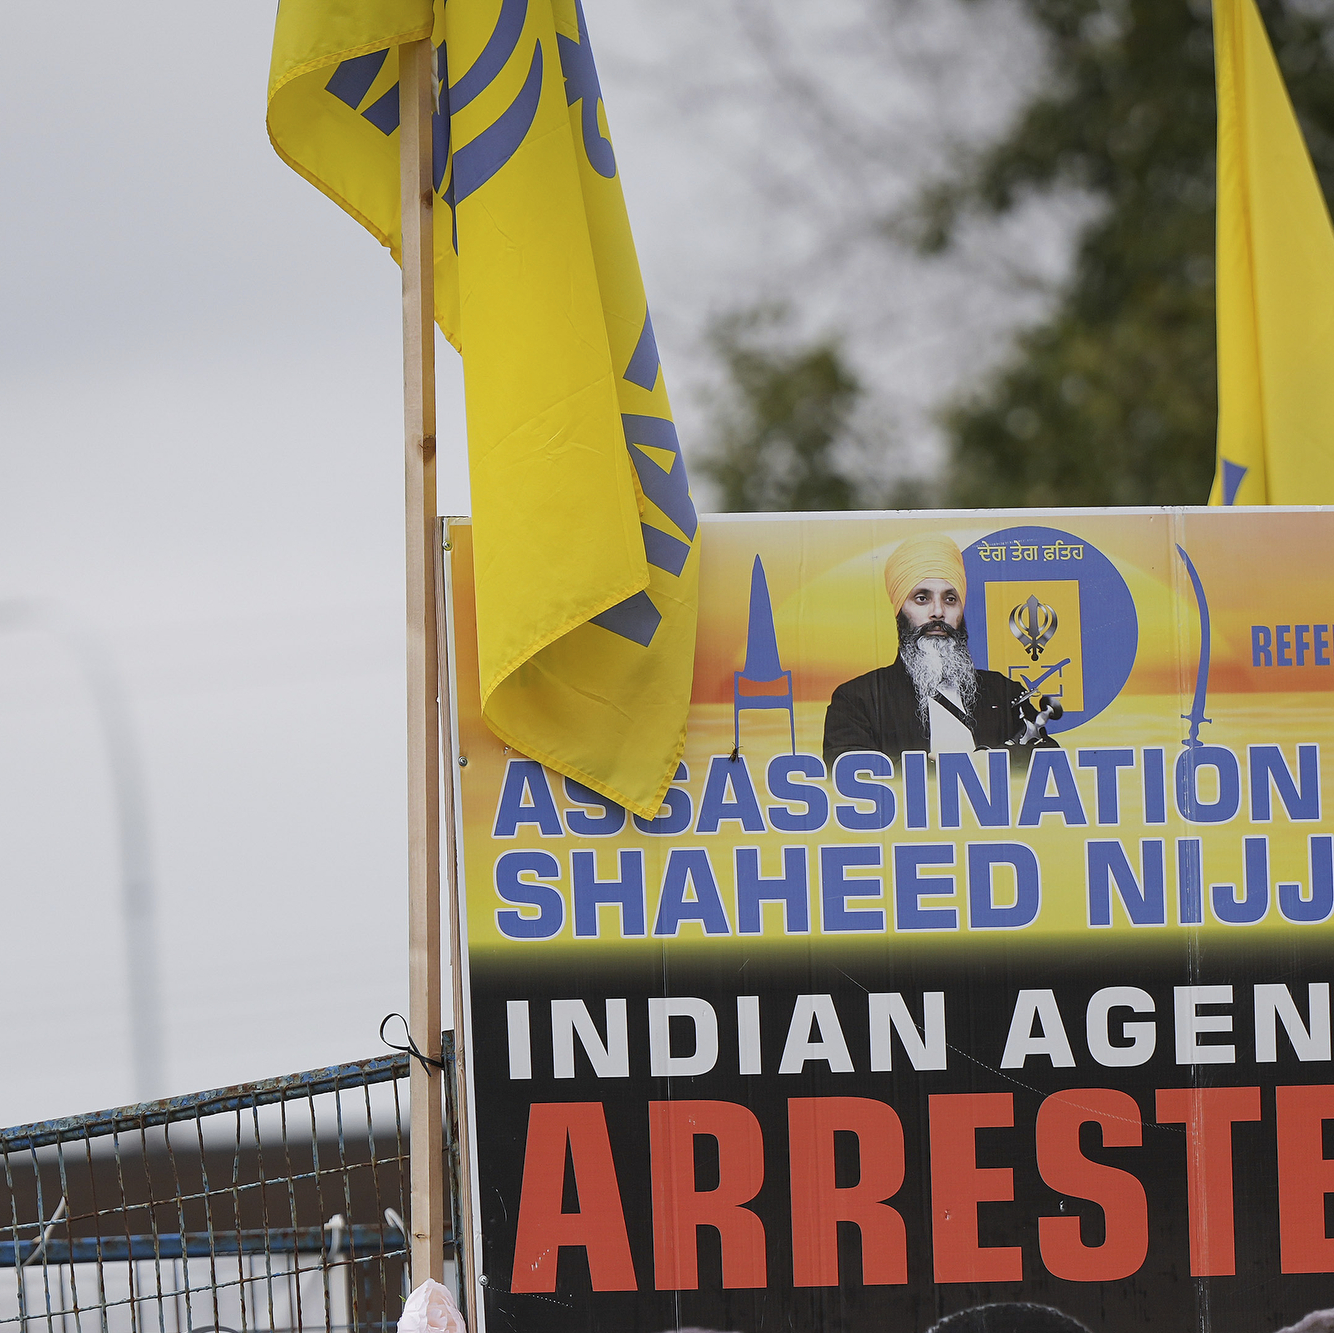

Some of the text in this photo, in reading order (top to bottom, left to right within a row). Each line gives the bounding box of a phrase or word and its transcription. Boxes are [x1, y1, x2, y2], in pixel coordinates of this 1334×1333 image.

[978, 540, 1007, 562] ਦੇਗ
[1010, 540, 1038, 562] ਤੇਗ
[492, 744, 1323, 839] ASSASSINATION
[493, 842, 1043, 941] SHAHEED
[507, 992, 946, 1079] INDIAN
